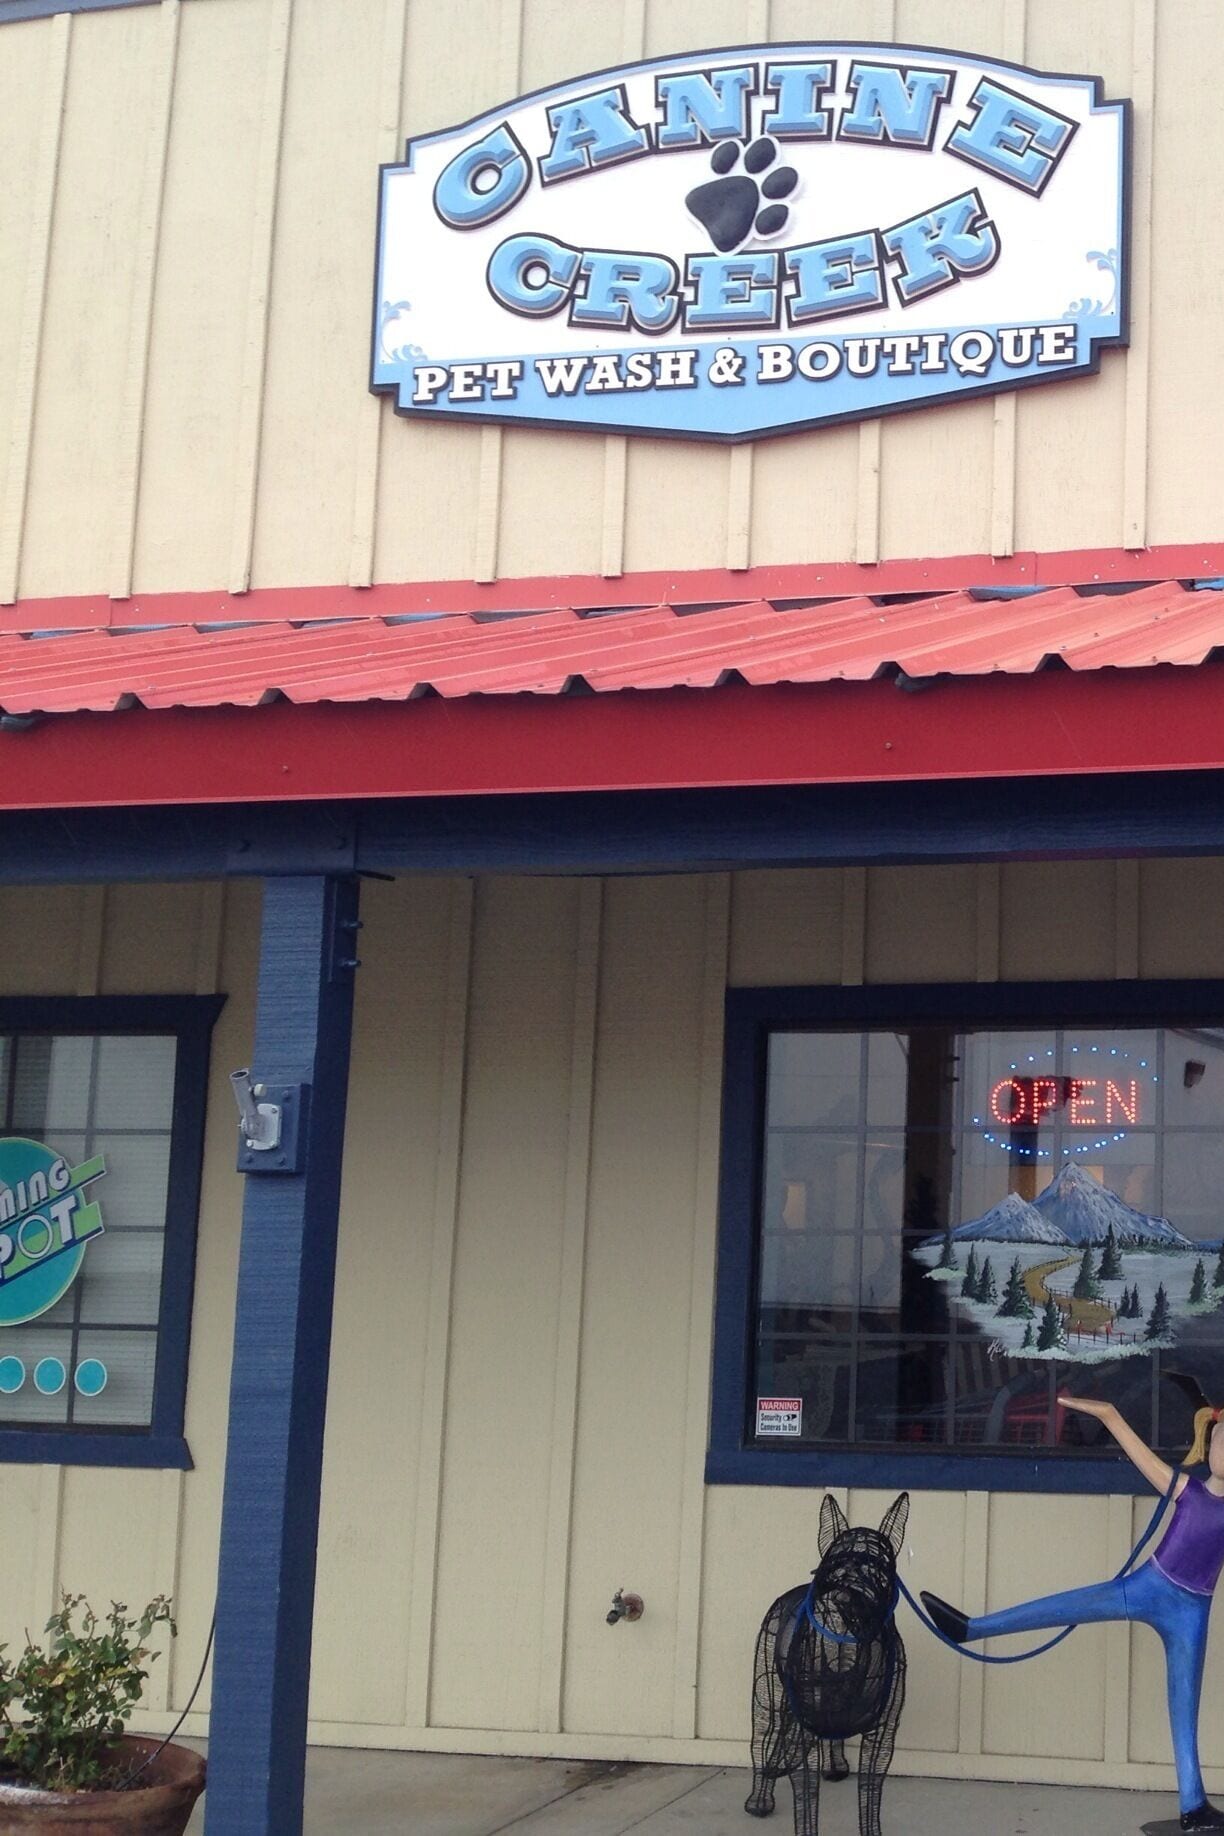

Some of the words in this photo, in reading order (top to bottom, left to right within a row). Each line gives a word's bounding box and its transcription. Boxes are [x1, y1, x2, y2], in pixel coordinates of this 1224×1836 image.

[433, 59, 1080, 231] CANINE
[486, 188, 1001, 335] CREEK
[412, 361, 523, 404] PET
[534, 350, 698, 397] WASH
[708, 347, 744, 387] &
[757, 325, 1076, 384] BOUTIQUE
[990, 1080, 1138, 1124] OPEN
[761, 1401, 799, 1410] WARNING
[761, 1413, 782, 1423] Security
[761, 1423, 781, 1431] Cameras
